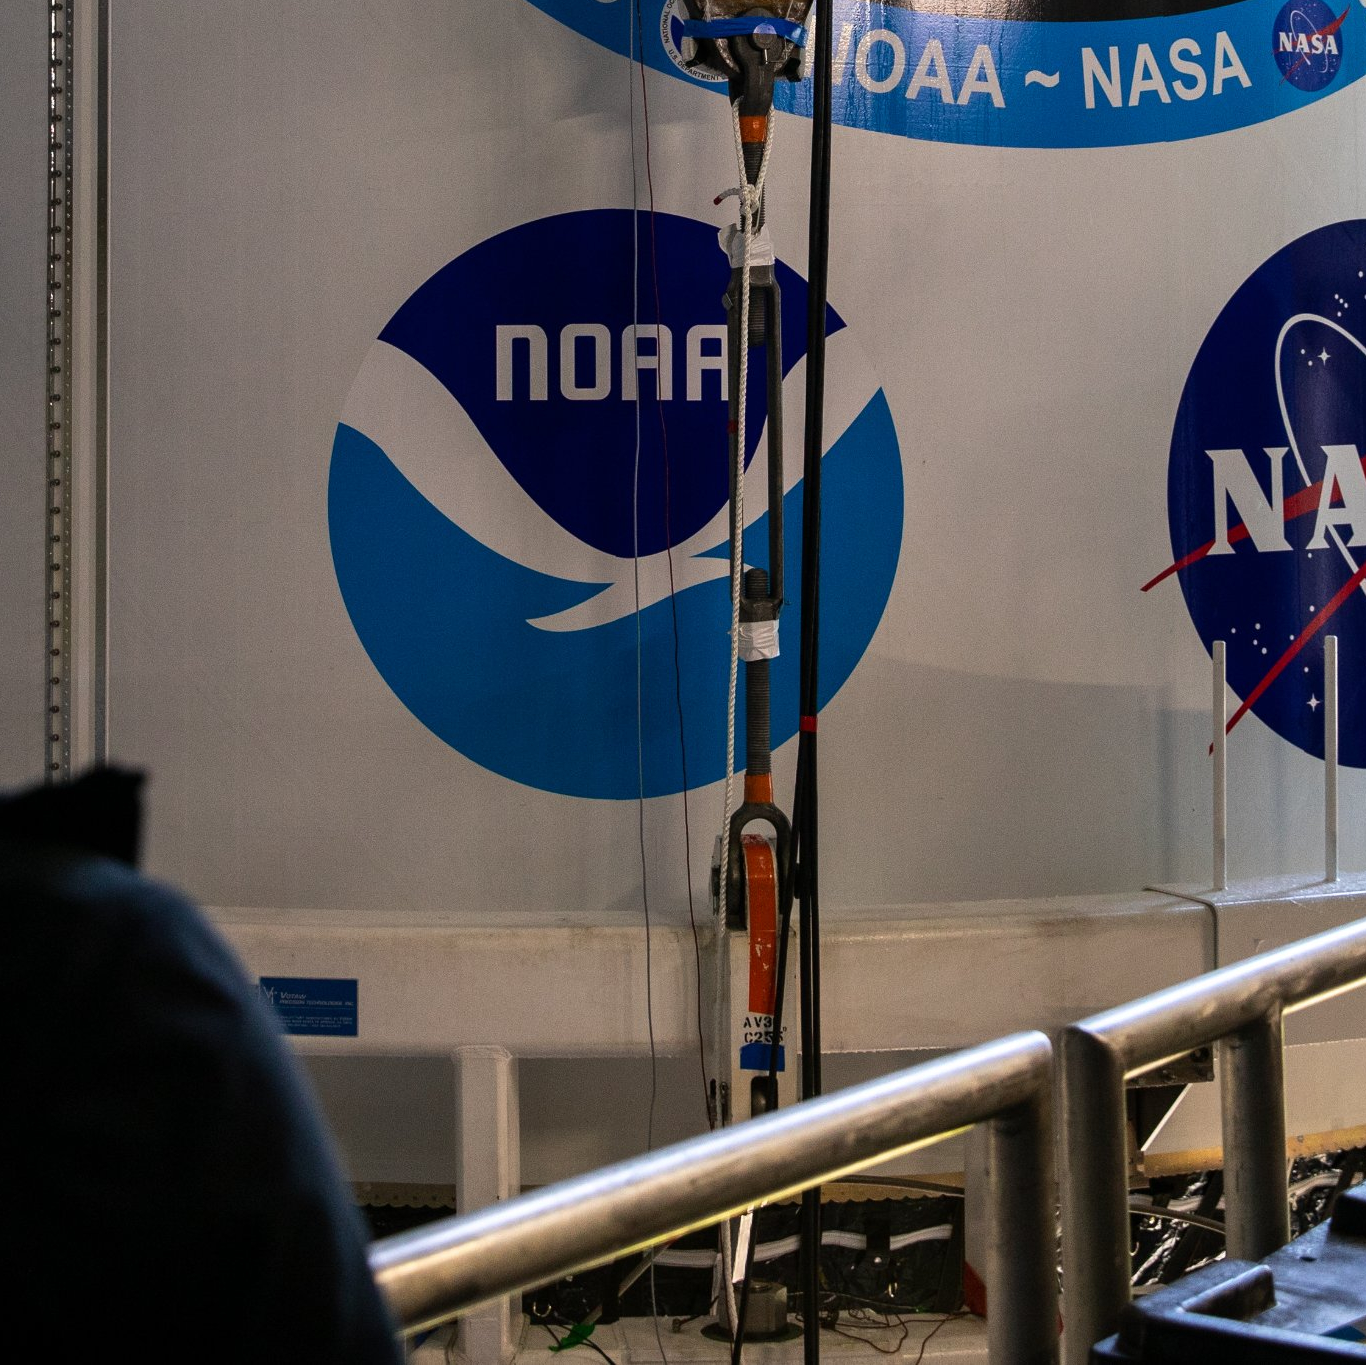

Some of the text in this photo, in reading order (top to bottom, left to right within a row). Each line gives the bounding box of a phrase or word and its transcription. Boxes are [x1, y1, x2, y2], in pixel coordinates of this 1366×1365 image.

[1081, 30, 1251, 110] NASA
[1278, 31, 1339, 56] NASA
[496, 323, 729, 401] NOAA
